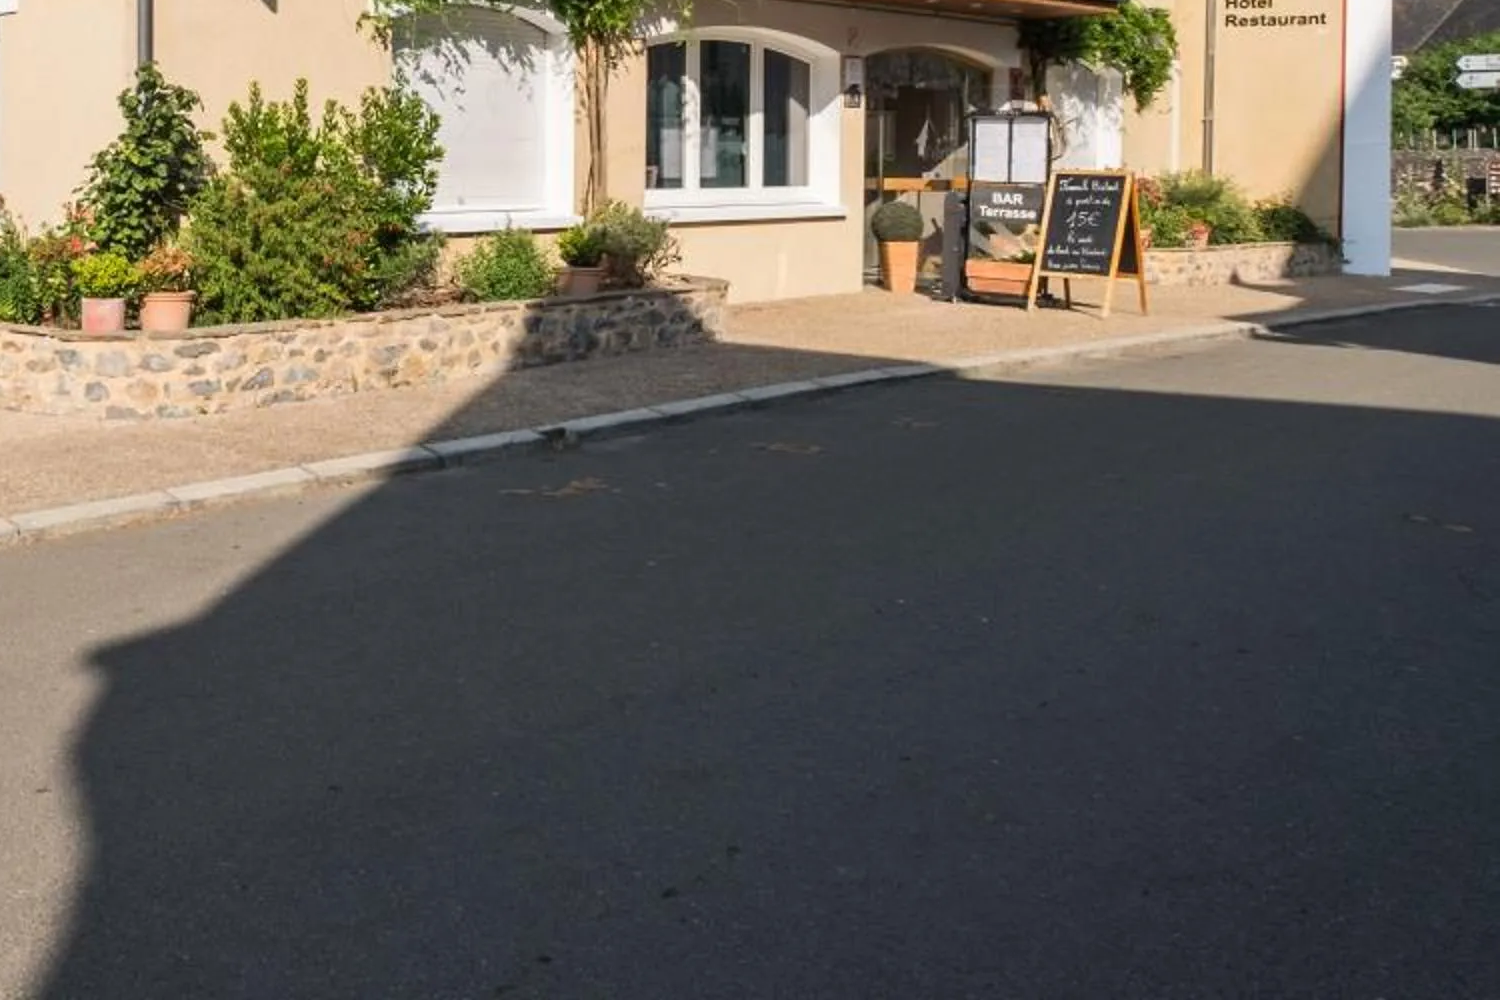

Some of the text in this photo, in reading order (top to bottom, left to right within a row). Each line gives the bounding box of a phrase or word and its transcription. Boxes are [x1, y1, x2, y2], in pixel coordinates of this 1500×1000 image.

[1225, 13, 1327, 27] Restaurant
[992, 192, 1024, 205] BAR
[979, 205, 1037, 219] Terrasse
